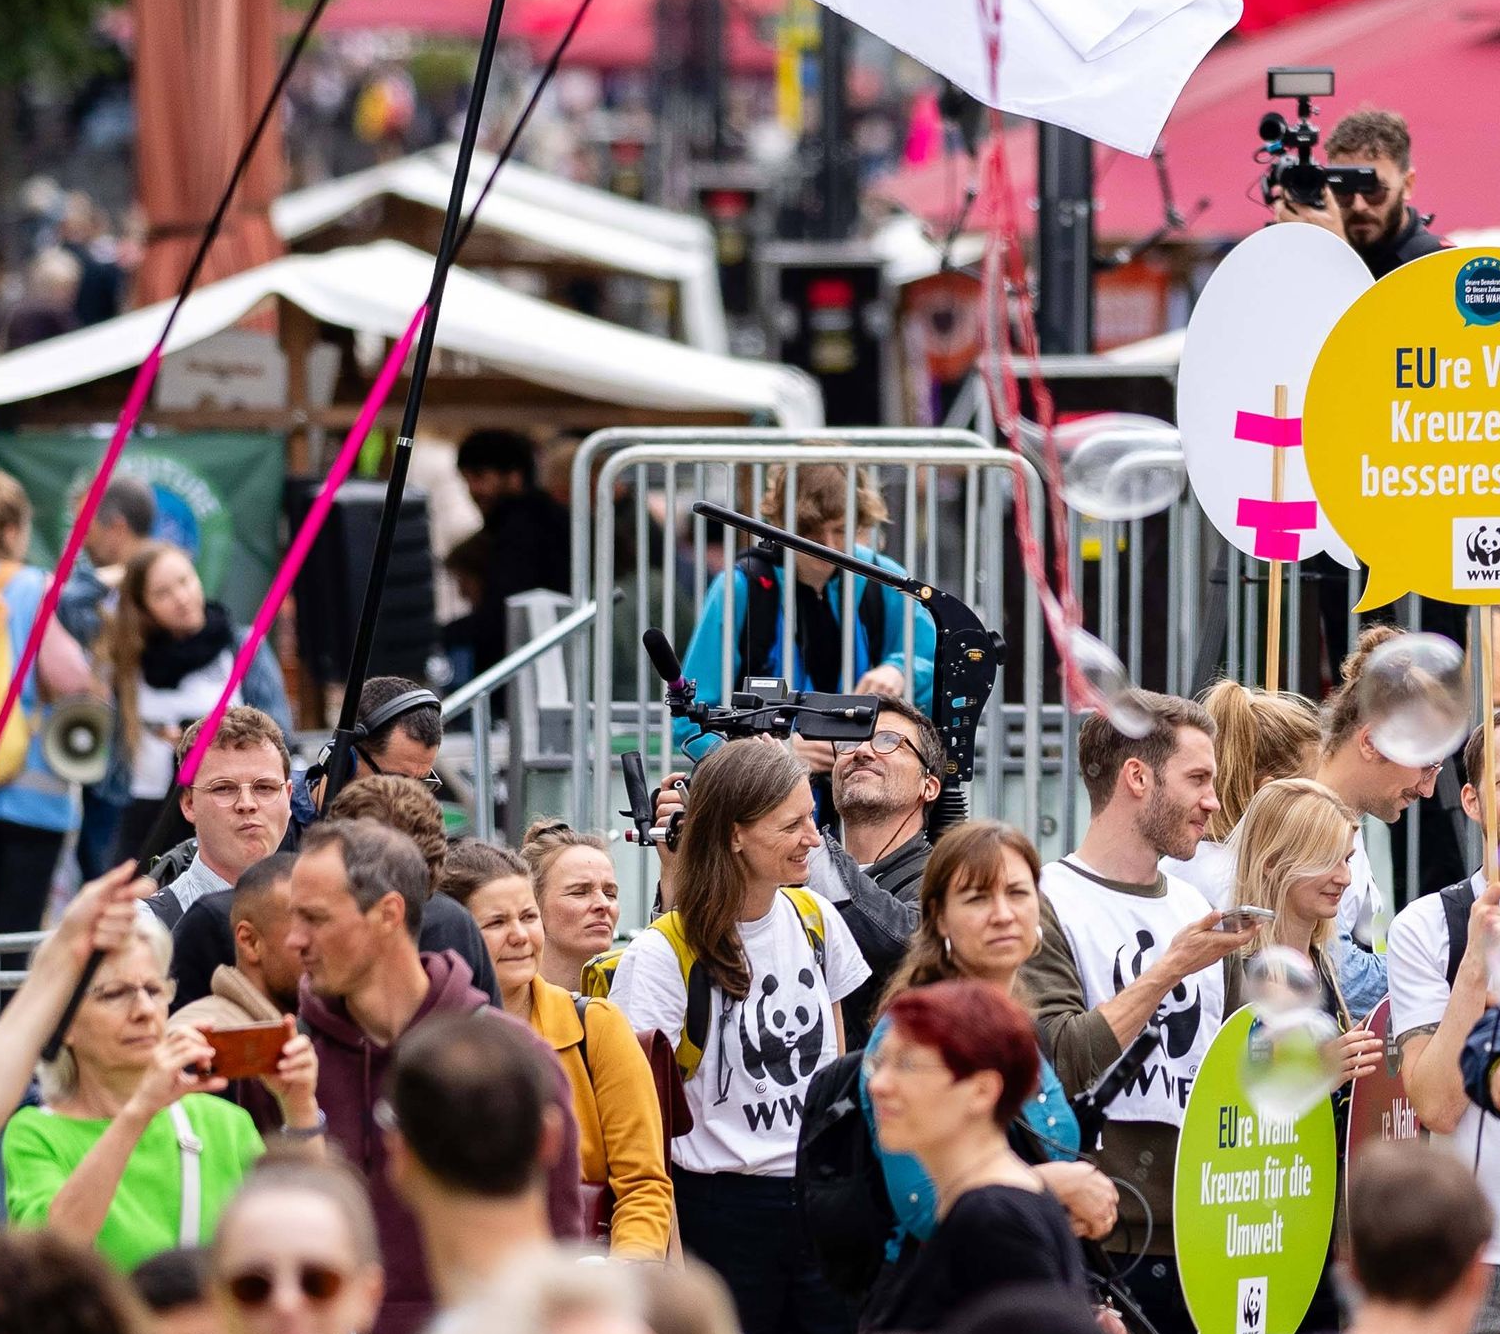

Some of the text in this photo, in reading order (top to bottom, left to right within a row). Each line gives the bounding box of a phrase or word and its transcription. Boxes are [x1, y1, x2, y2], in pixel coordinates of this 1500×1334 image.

[1465, 294, 1485, 304] DEINE
[1395, 347, 1472, 390] EUre
[1219, 1106, 1252, 1148] EUre
[1201, 1153, 1311, 1205] Kreuzen für die
[1226, 1210, 1283, 1257] Umwelt
